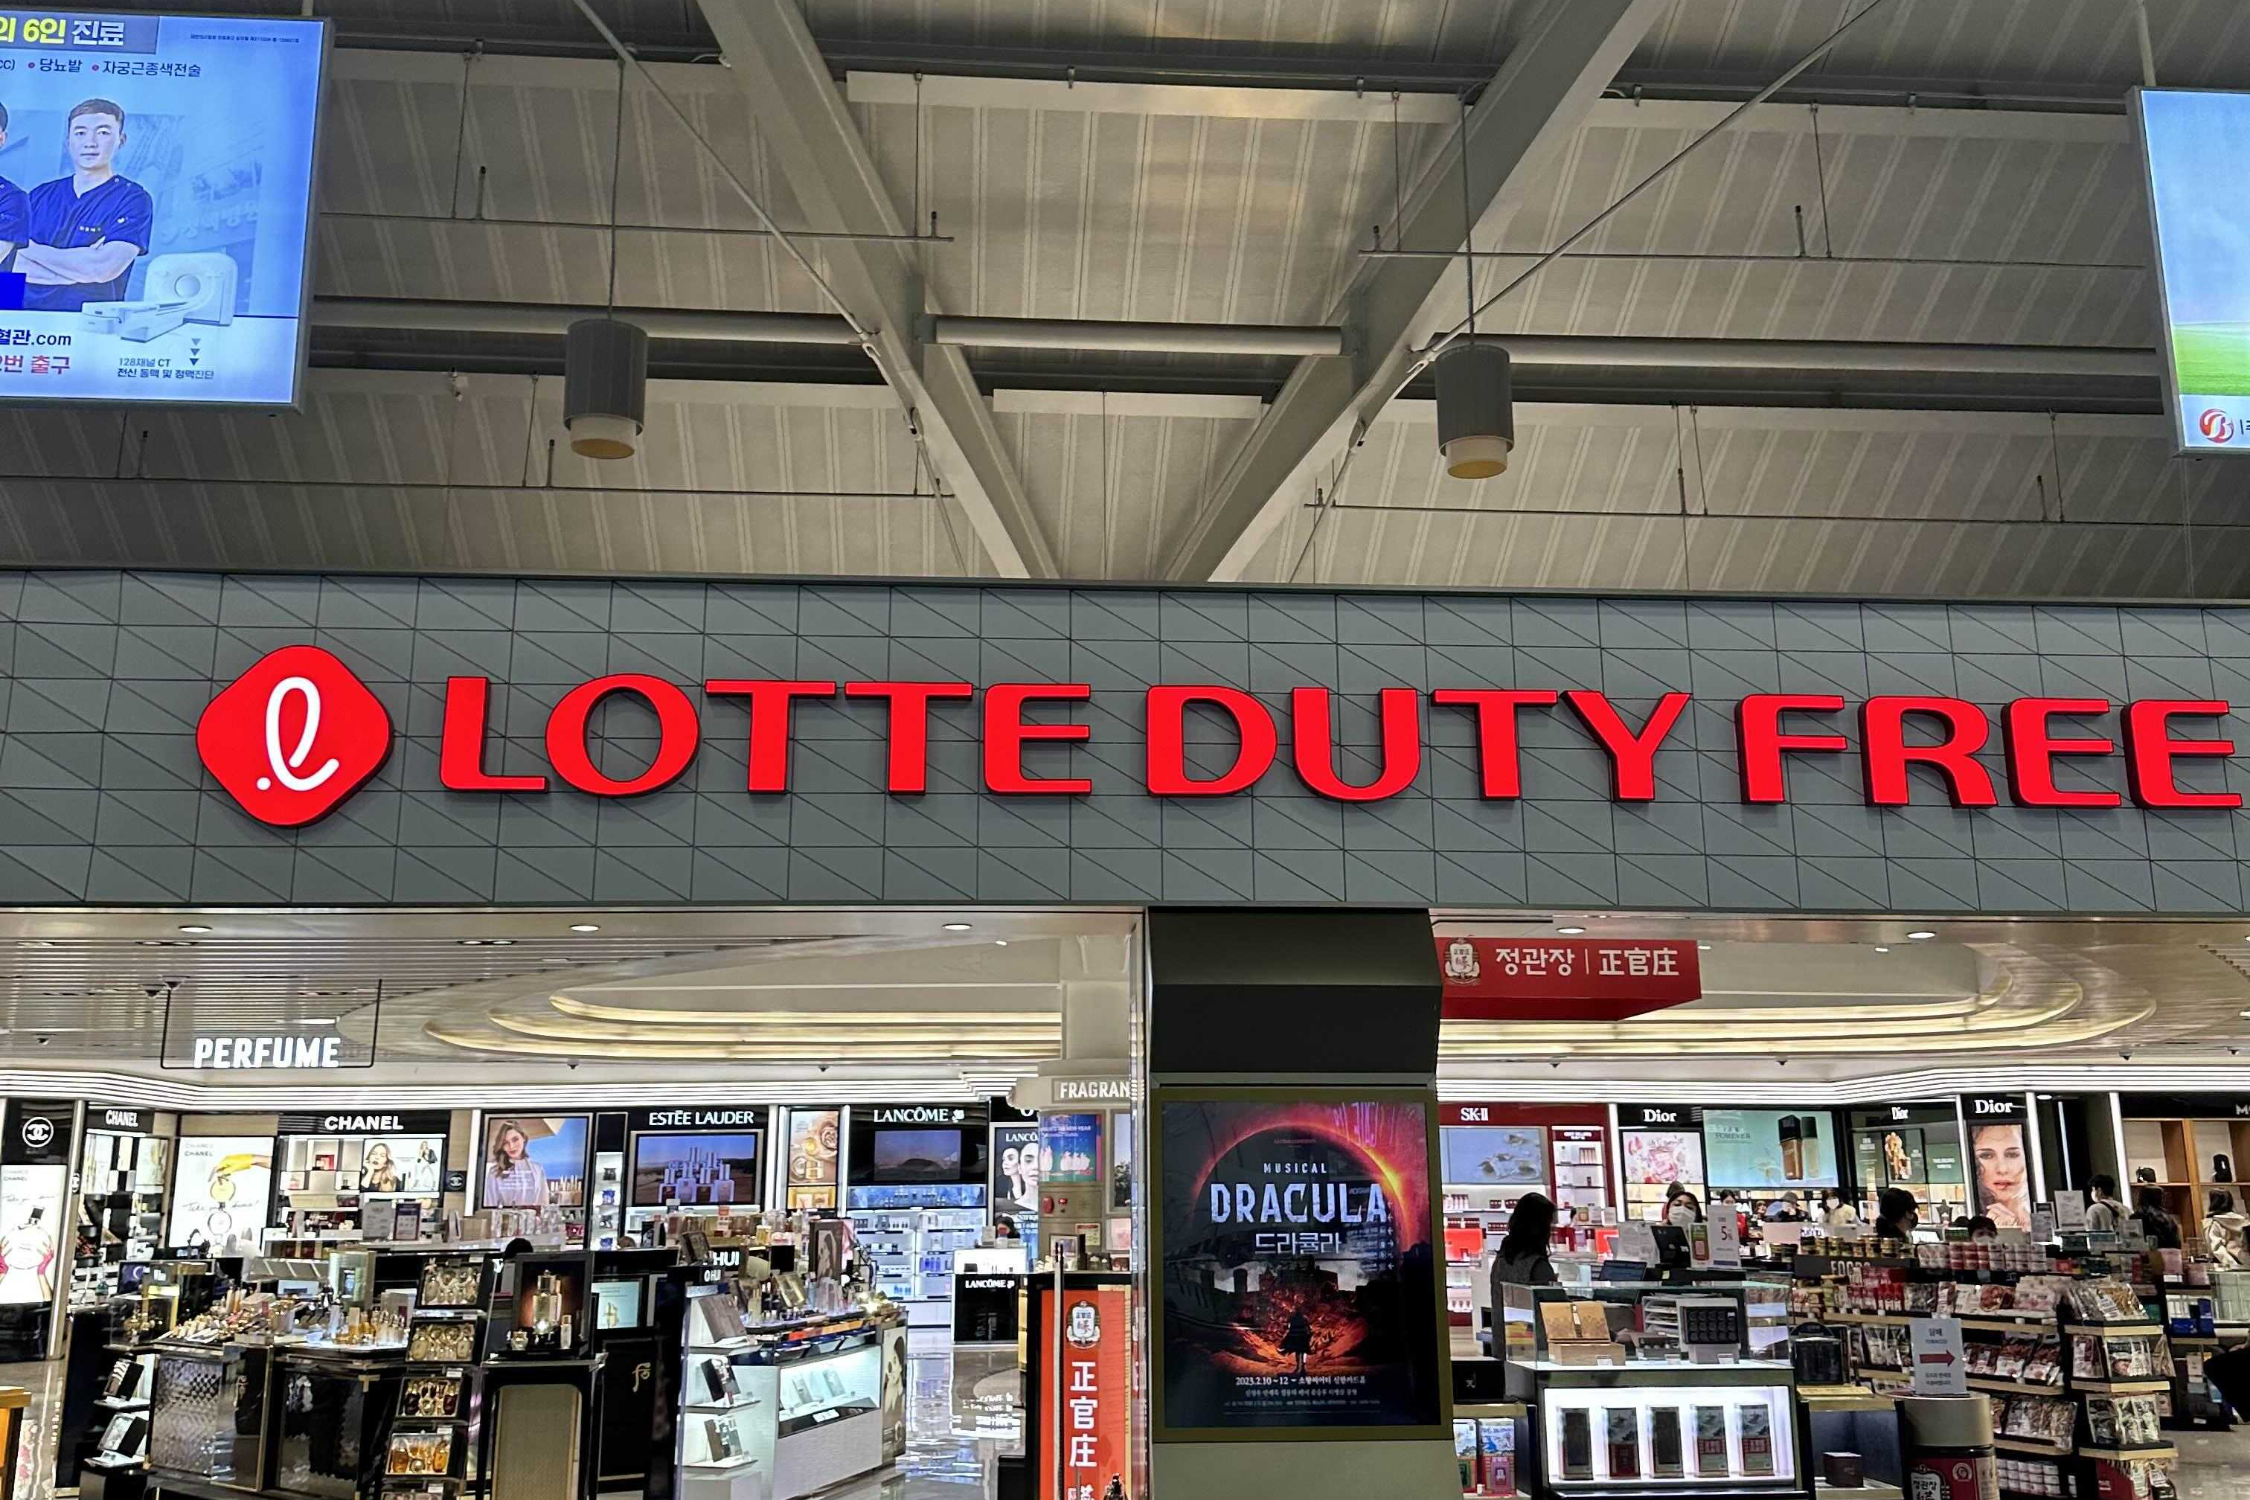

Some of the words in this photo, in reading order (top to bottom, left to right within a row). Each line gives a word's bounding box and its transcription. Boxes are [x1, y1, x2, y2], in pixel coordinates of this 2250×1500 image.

[23, 18, 67, 44] 6인
[71, 20, 125, 46] 진료
[40, 58, 82, 73] 당뇨발
[103, 61, 201, 78] 자궁근종색전술
[31, 355, 70, 375] 출구
[119, 357, 156, 368] 128채널
[157, 358, 171, 368] CT
[117, 368, 137, 378] 전신
[140, 368, 160, 379] 동맥
[162, 369, 173, 379] 및
[439, 674, 1093, 798] LOTTE
[1146, 685, 1692, 803] DUTY
[1737, 694, 2243, 810] FREE
[1495, 947, 1576, 977] 정관장
[1598, 947, 1680, 977] 正官庄
[194, 1036, 341, 1069] PERFUME
[873, 1106, 949, 1123] LANCÔME
[1460, 1107, 1489, 1122] SK-II
[1891, 1106, 1909, 1120] Dior
[1974, 1099, 2014, 1114] Dior
[2235, 1104, 2250, 1116] M
[105, 1109, 139, 1128] CHANEL
[324, 1115, 404, 1131] CHANEL
[694, 1110, 754, 1125] LAUDER
[1643, 1108, 1677, 1123] Dior
[1263, 1162, 1328, 1174] MUSICAL
[1210, 1183, 1387, 1223] DRACULA
[1254, 1232, 1342, 1255] 드라큘라
[965, 1279, 1007, 1289] LANCÔME
[1069, 1361, 1099, 1468] 正官庄
